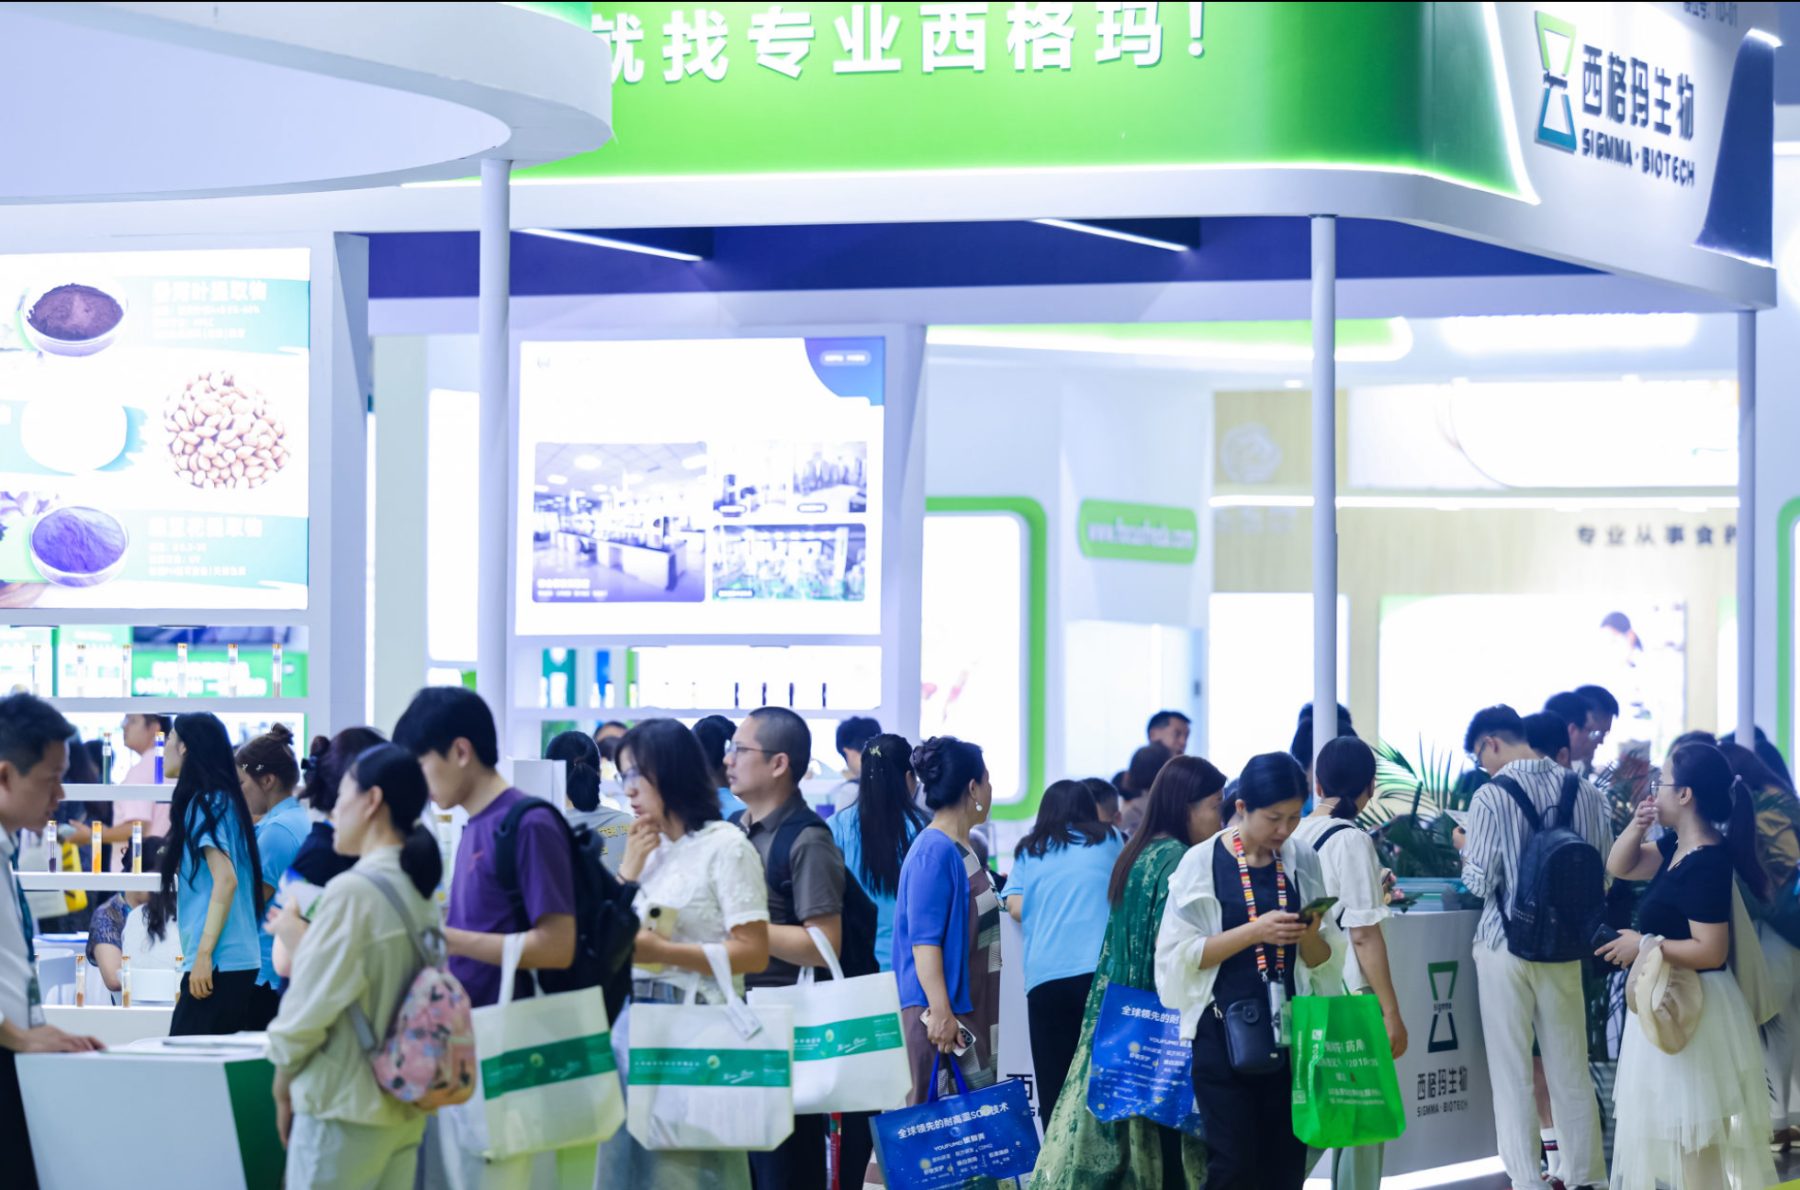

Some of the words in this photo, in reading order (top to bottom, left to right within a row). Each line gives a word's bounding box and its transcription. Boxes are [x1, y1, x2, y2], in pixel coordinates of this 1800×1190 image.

[1583, 44, 1694, 141] 西格玛生物
[1417, 1066, 1468, 1100] 西格玛生物
